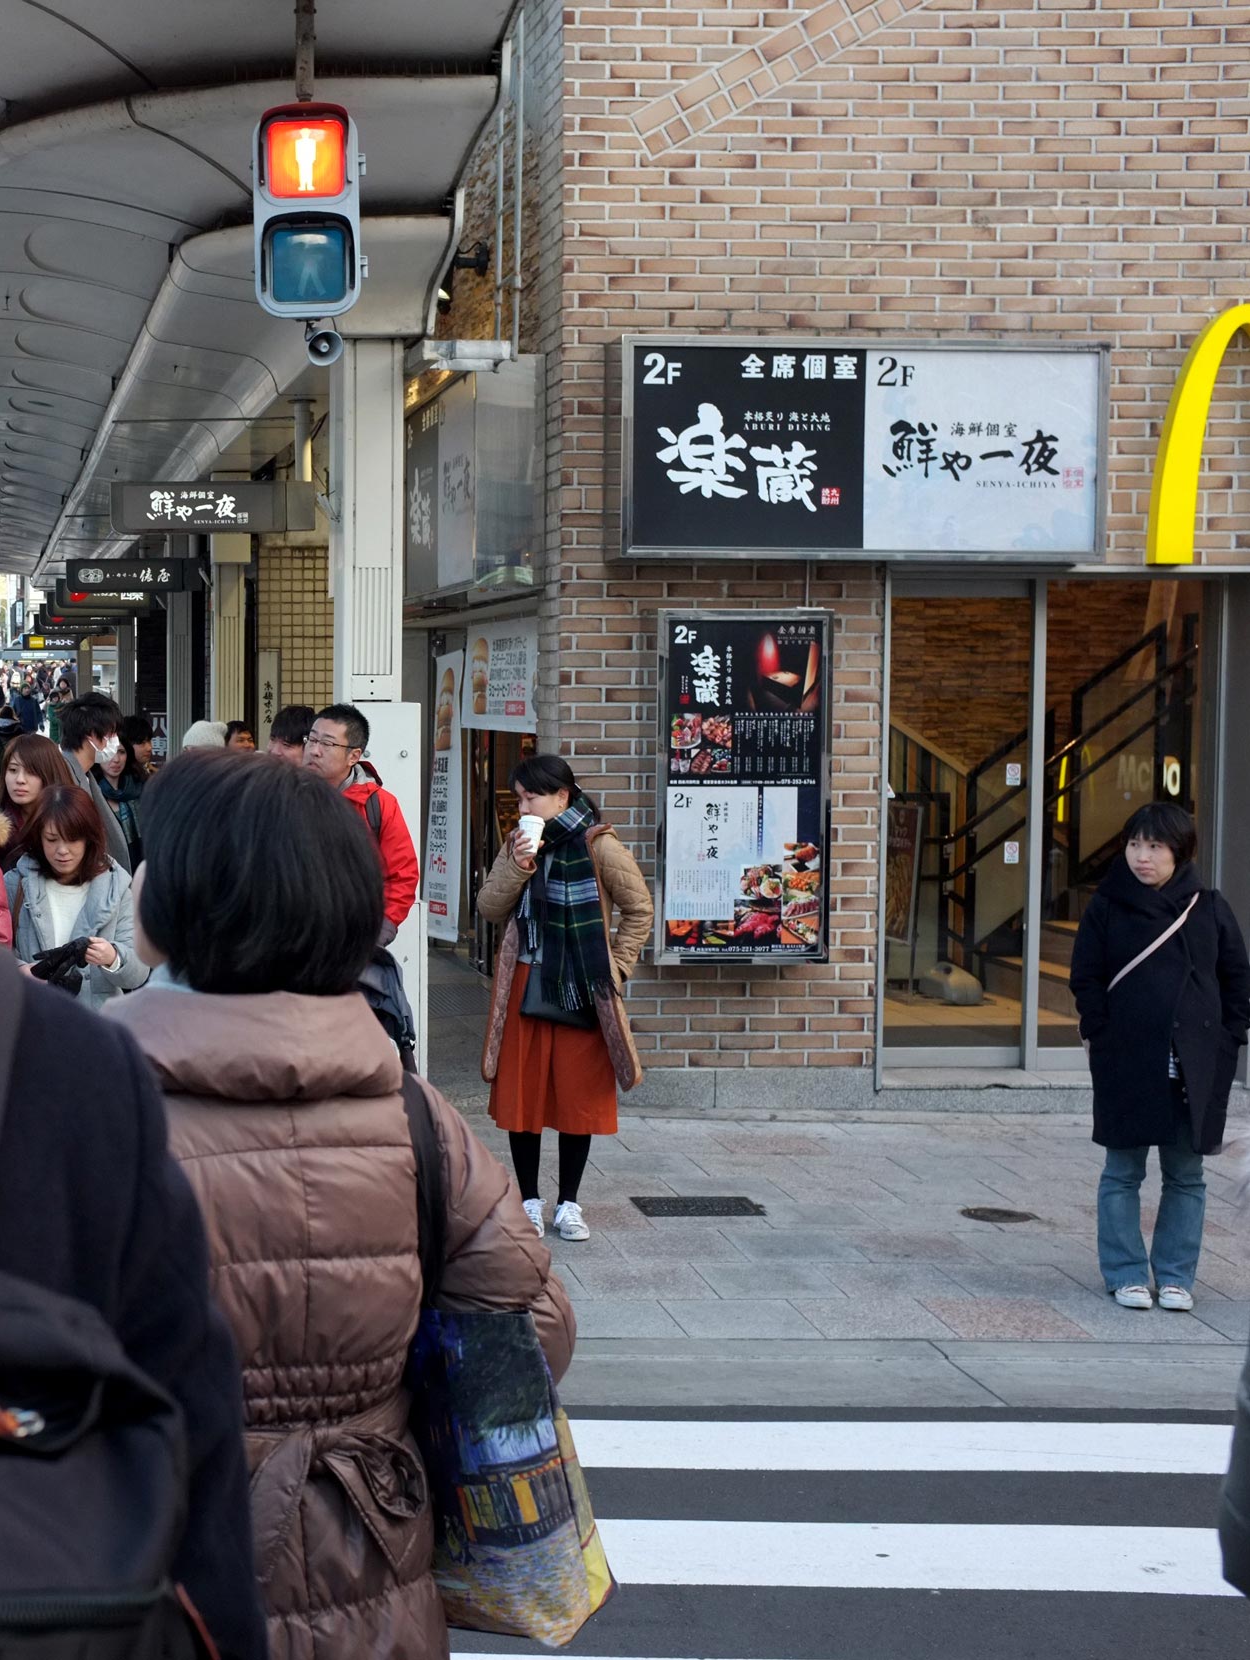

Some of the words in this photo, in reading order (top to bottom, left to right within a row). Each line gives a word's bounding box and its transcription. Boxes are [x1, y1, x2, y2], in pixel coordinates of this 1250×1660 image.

[643, 353, 682, 384] 2F
[741, 353, 858, 379] 全席個室
[877, 357, 915, 387] 2F
[743, 423, 780, 431] ABURI
[788, 423, 831, 432] DINING
[744, 411, 783, 422] 本格炙り
[789, 411, 830, 423] 海と大地
[950, 421, 1018, 438] 海鮮個室
[656, 403, 817, 512] 楽蔵
[882, 419, 1060, 481] 鮮や一夜
[180, 491, 215, 500] 海鮮個室
[976, 481, 1056, 489] SENYA-ICHIYA
[146, 490, 237, 522] 鮮や一夜
[674, 625, 697, 644] 2F
[690, 645, 721, 707] 楽蔵
[674, 793, 693, 808] 2F
[704, 803, 721, 859] 鮮や一夜
